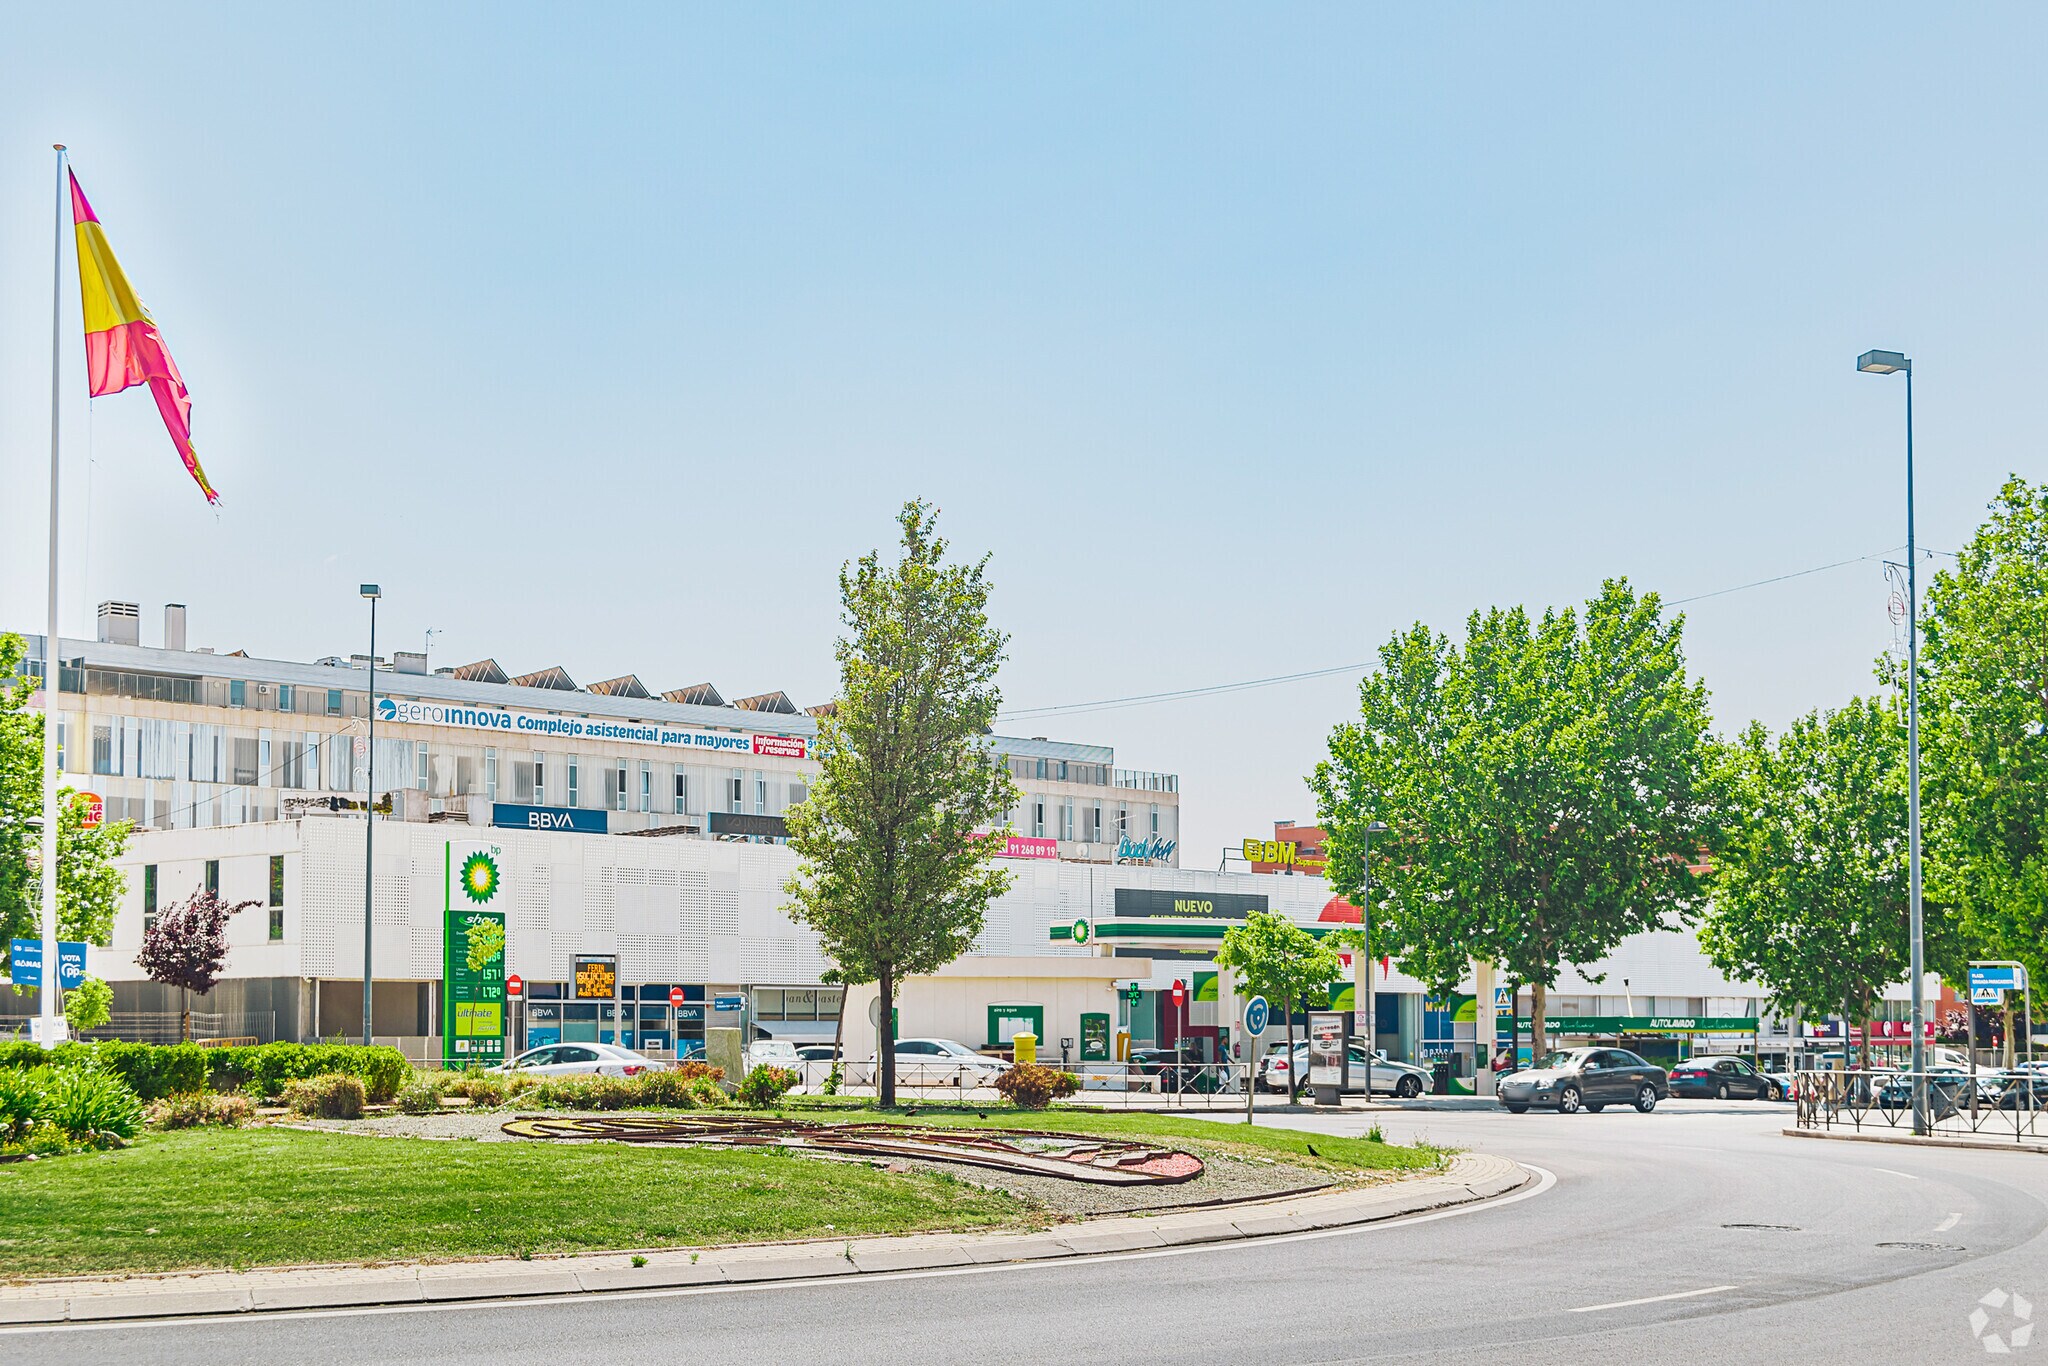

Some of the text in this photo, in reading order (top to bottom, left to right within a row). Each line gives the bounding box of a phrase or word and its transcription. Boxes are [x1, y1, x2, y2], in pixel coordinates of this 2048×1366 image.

[398, 702, 750, 751] geroinnova Complejo asistencial para mayores
[754, 735, 803, 748] Información
[757, 746, 764, 755] y
[765, 745, 800, 757] reservas
[528, 811, 575, 828] BBVA
[490, 844, 502, 856] bp
[1010, 843, 1020, 854] 91
[1021, 844, 1035, 855] 268
[1036, 845, 1045, 856] 89
[1046, 846, 1056, 857] 19
[1117, 835, 1177, 864] Bodybell
[1264, 840, 1297, 864] BM
[1174, 899, 1214, 913] NUEVO
[61, 954, 81, 962] VOTA
[587, 963, 605, 972] FERIA
[802, 989, 814, 1004] &
[532, 1008, 554, 1017] BBVA
[677, 1009, 698, 1018] BBVA
[1649, 1018, 1696, 1029] AUTOLAVADO
